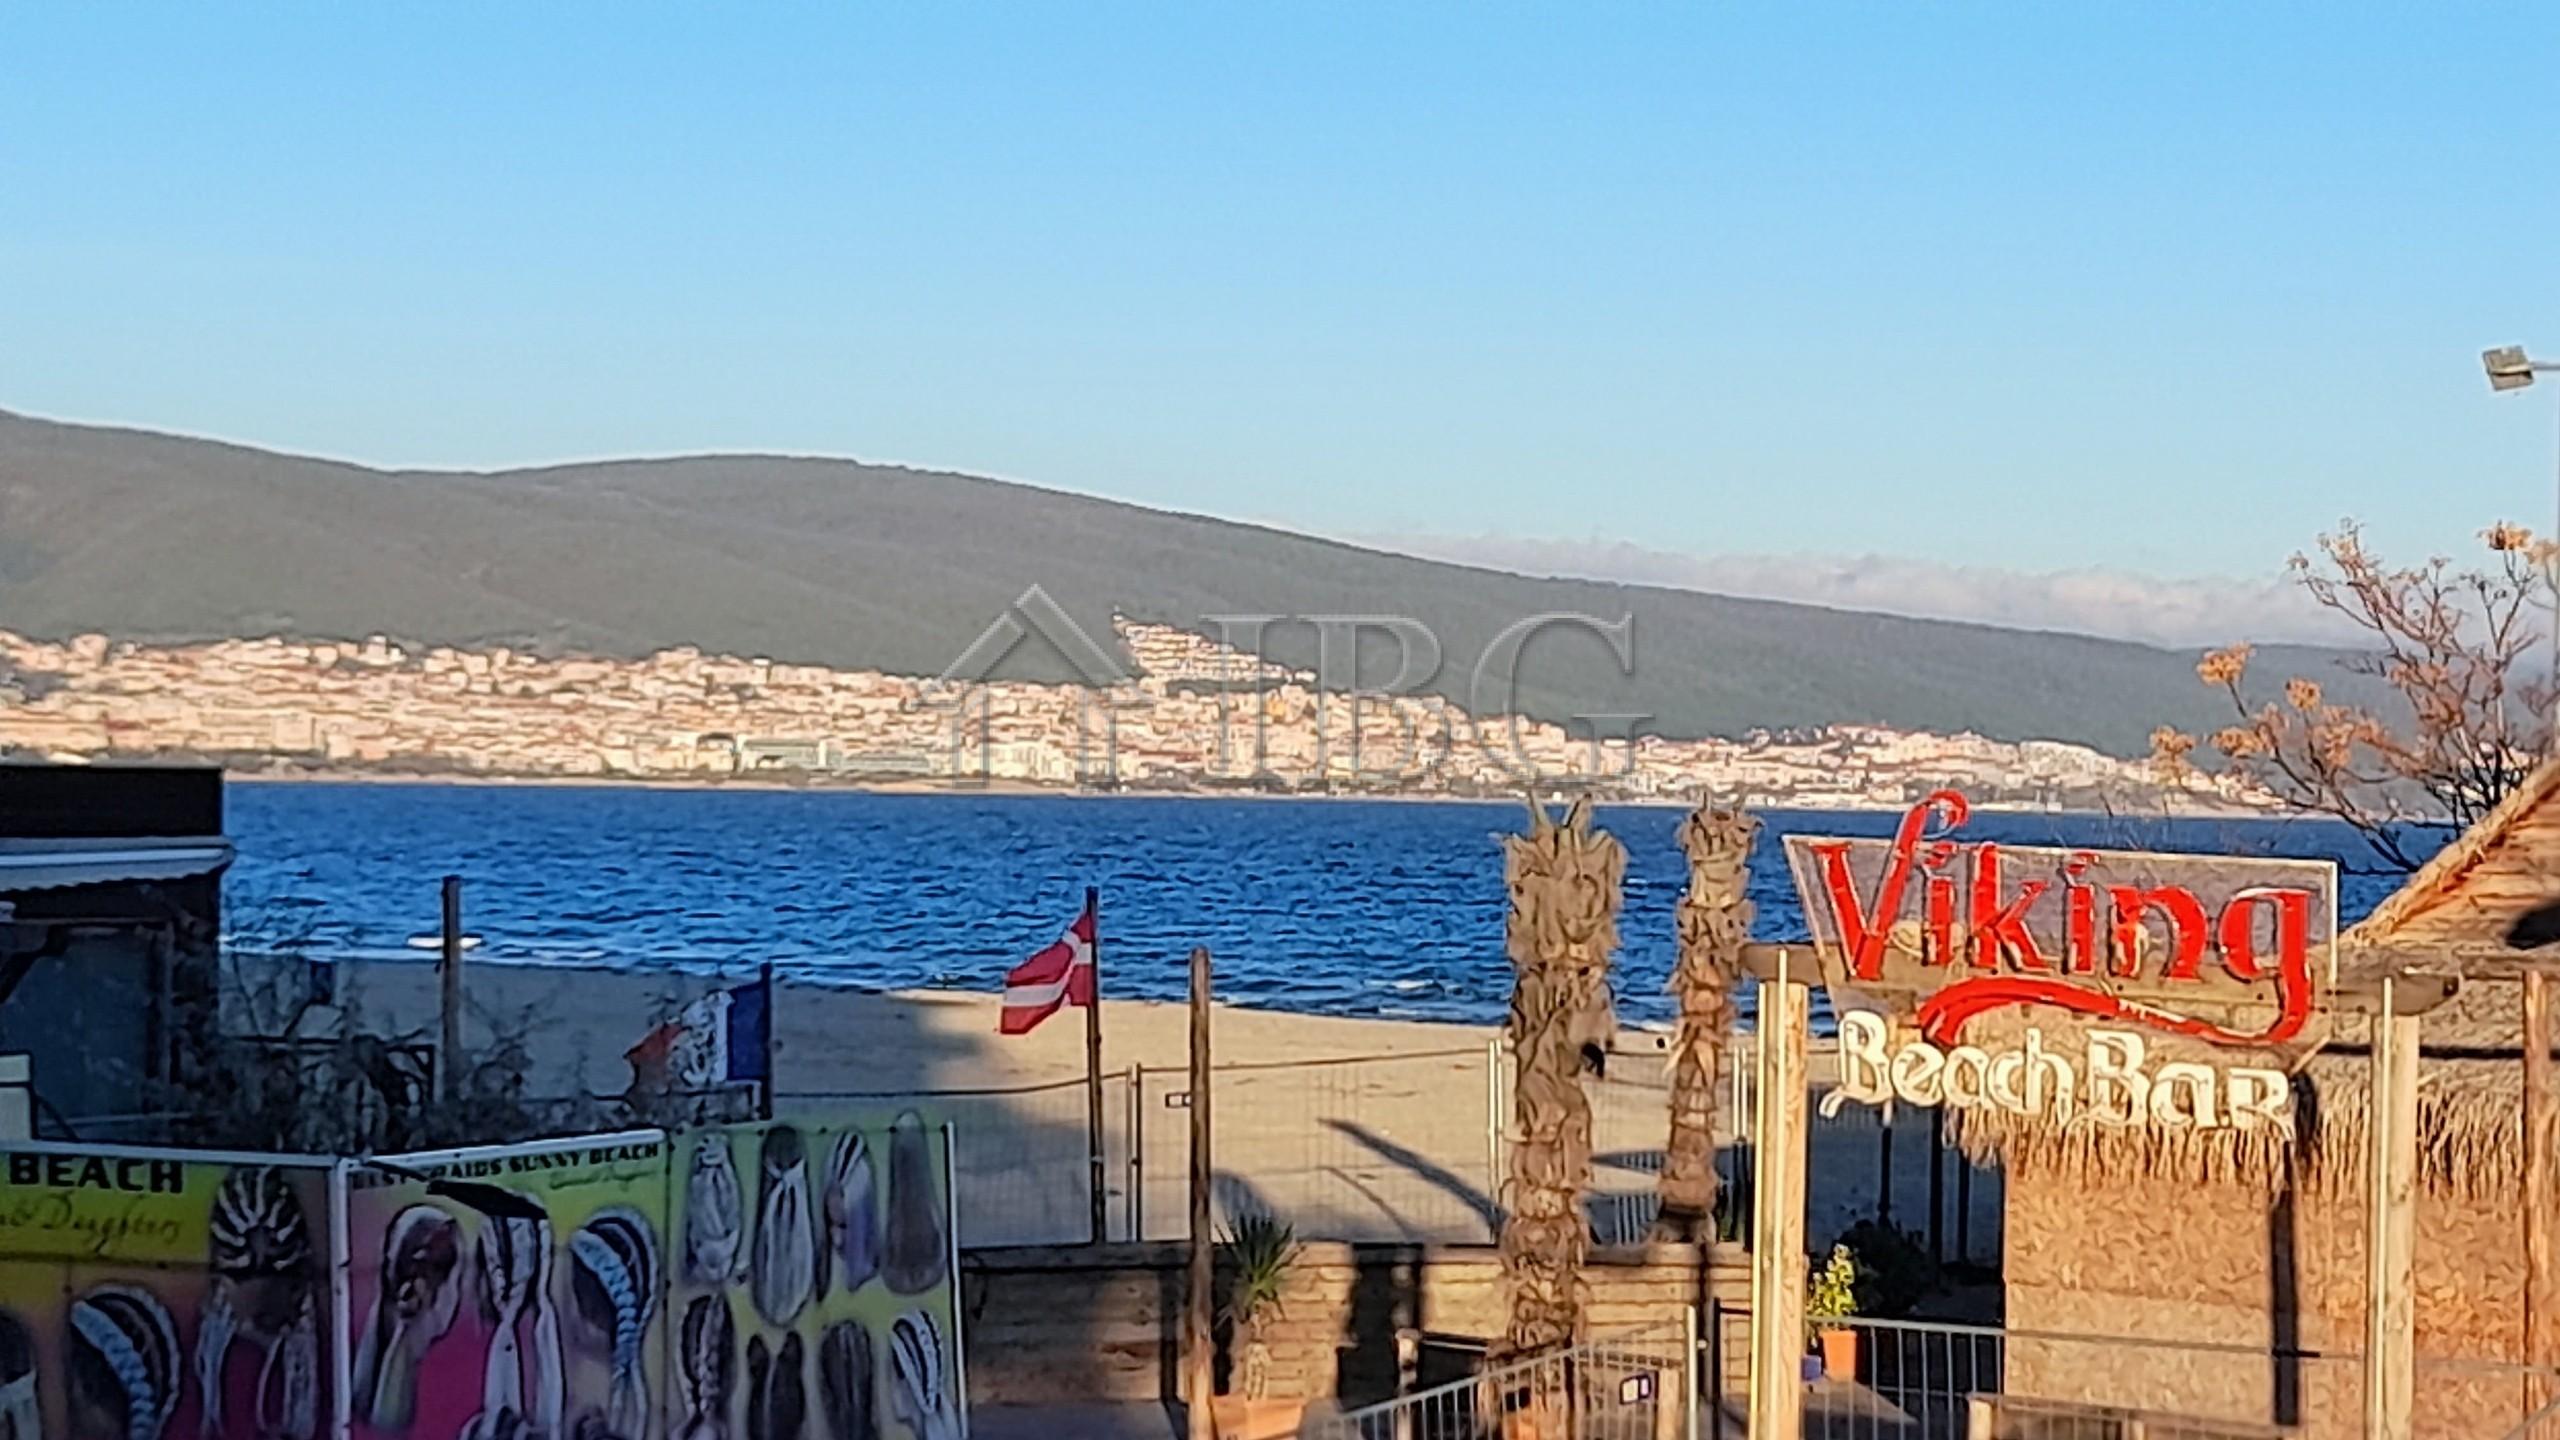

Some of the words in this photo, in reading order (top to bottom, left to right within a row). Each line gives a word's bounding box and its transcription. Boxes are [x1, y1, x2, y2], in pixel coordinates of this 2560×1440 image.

[1811, 789, 2313, 1042] Viking
[1819, 1010, 2074, 1127] Beach
[9, 1152, 184, 1194] BEACH
